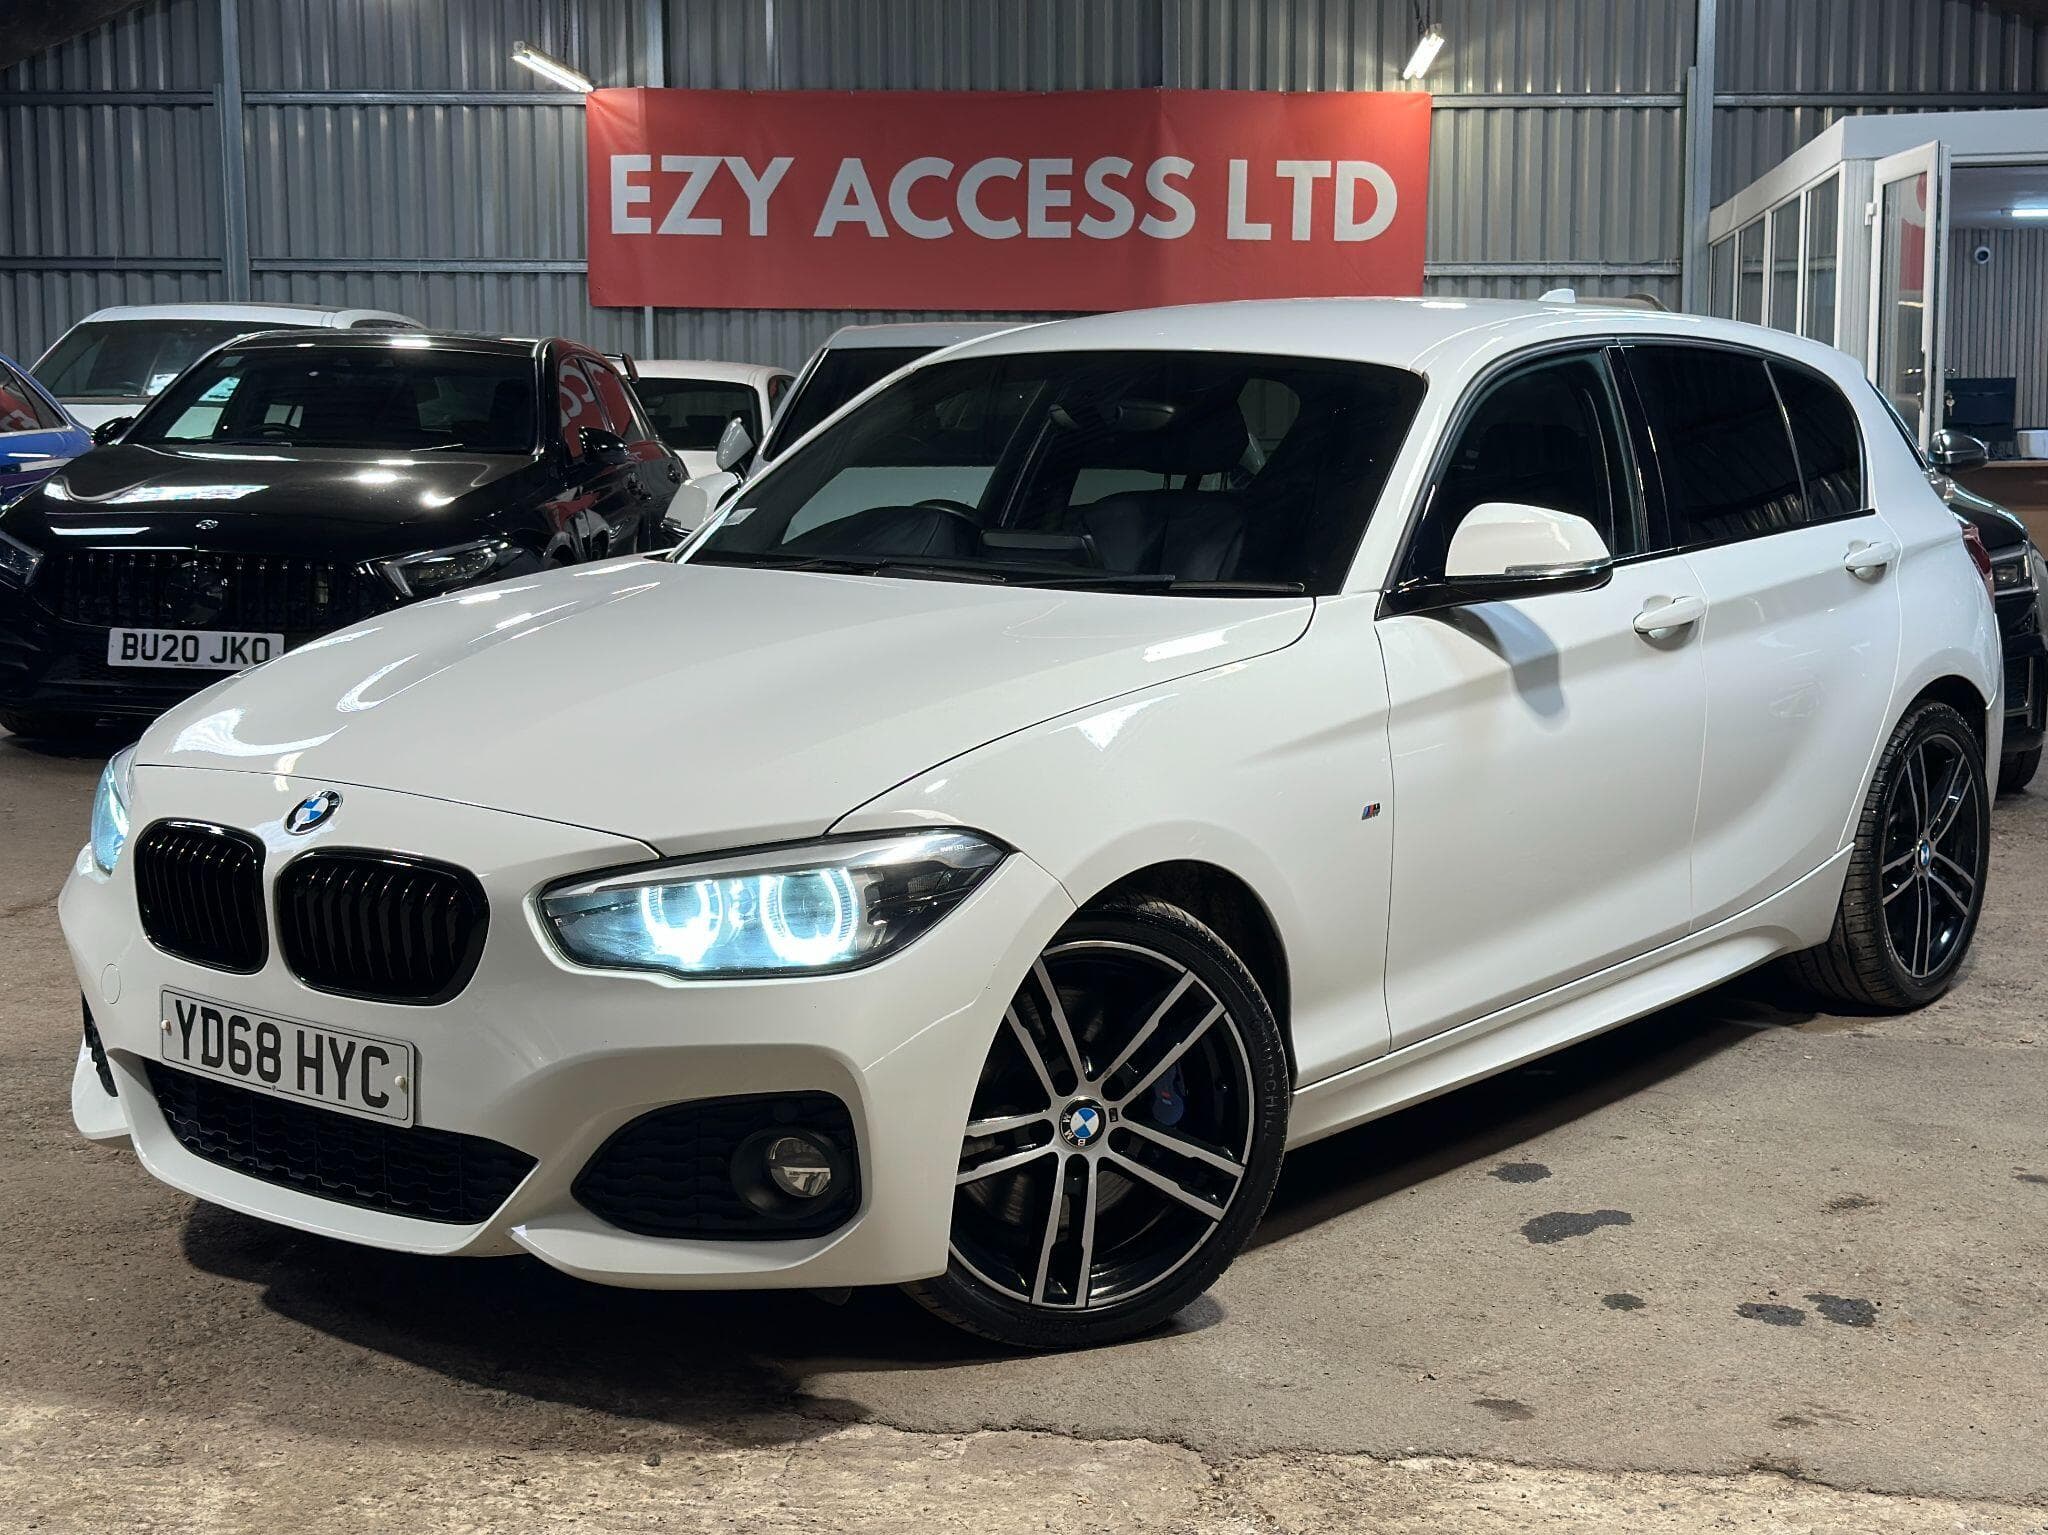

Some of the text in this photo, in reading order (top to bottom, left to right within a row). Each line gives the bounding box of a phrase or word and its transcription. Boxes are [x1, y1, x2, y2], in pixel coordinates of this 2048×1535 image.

[610, 154, 1398, 242] EZY ACCESS LTD
[121, 633, 271, 665] BU20 JKO
[175, 999, 390, 1108] YD68 HYC
